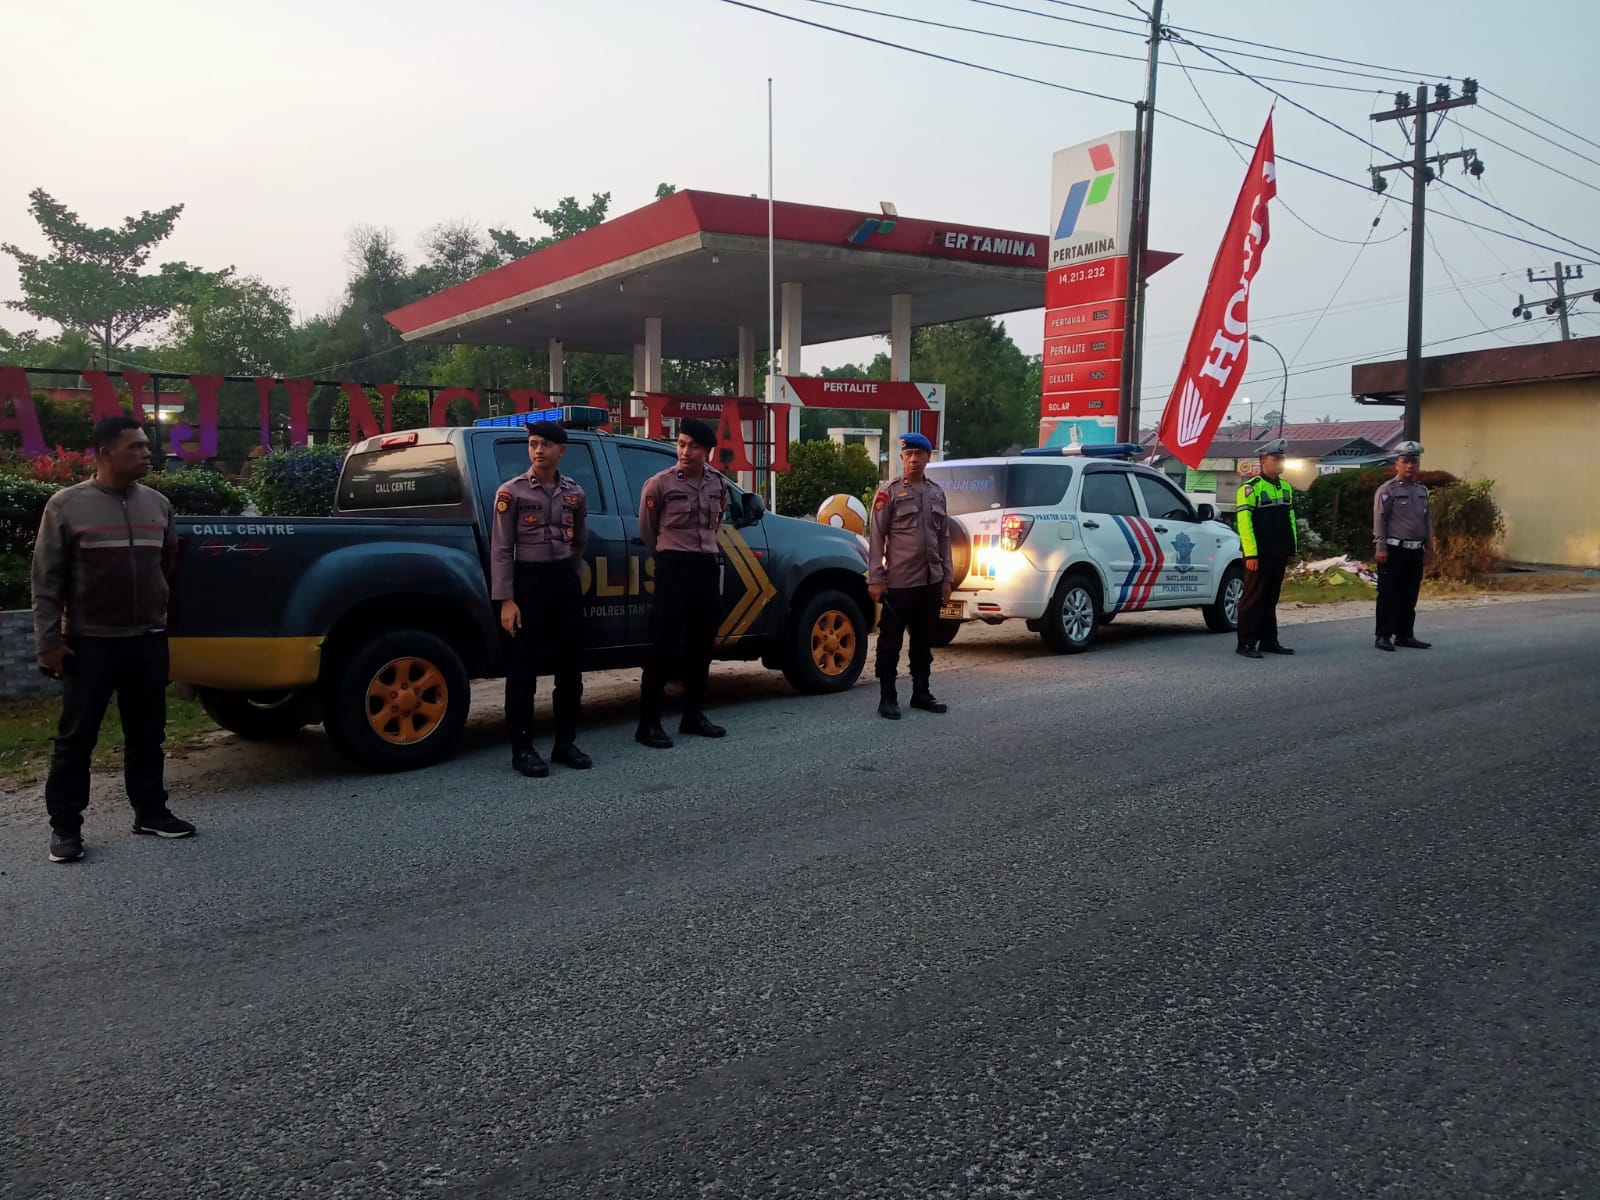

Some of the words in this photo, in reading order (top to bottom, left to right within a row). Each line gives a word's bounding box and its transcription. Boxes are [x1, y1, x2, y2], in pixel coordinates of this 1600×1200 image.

[1053, 237, 1115, 263] PERTAMINA
[1059, 266, 1105, 284] 14.213.232
[1051, 315, 1086, 327] PERTAMAX
[1050, 343, 1086, 356] PERTALITE
[1049, 373, 1074, 384] DEXLITE
[780, 384, 786, 399] 1
[823, 382, 878, 394] PERTALITE
[1048, 402, 1070, 412] SOLAR
[375, 483, 391, 494] CALL
[391, 480, 416, 492] CENTRE
[193, 524, 232, 535] CALL
[237, 524, 295, 535] CENTRE
[590, 604, 625, 617] POLRES
